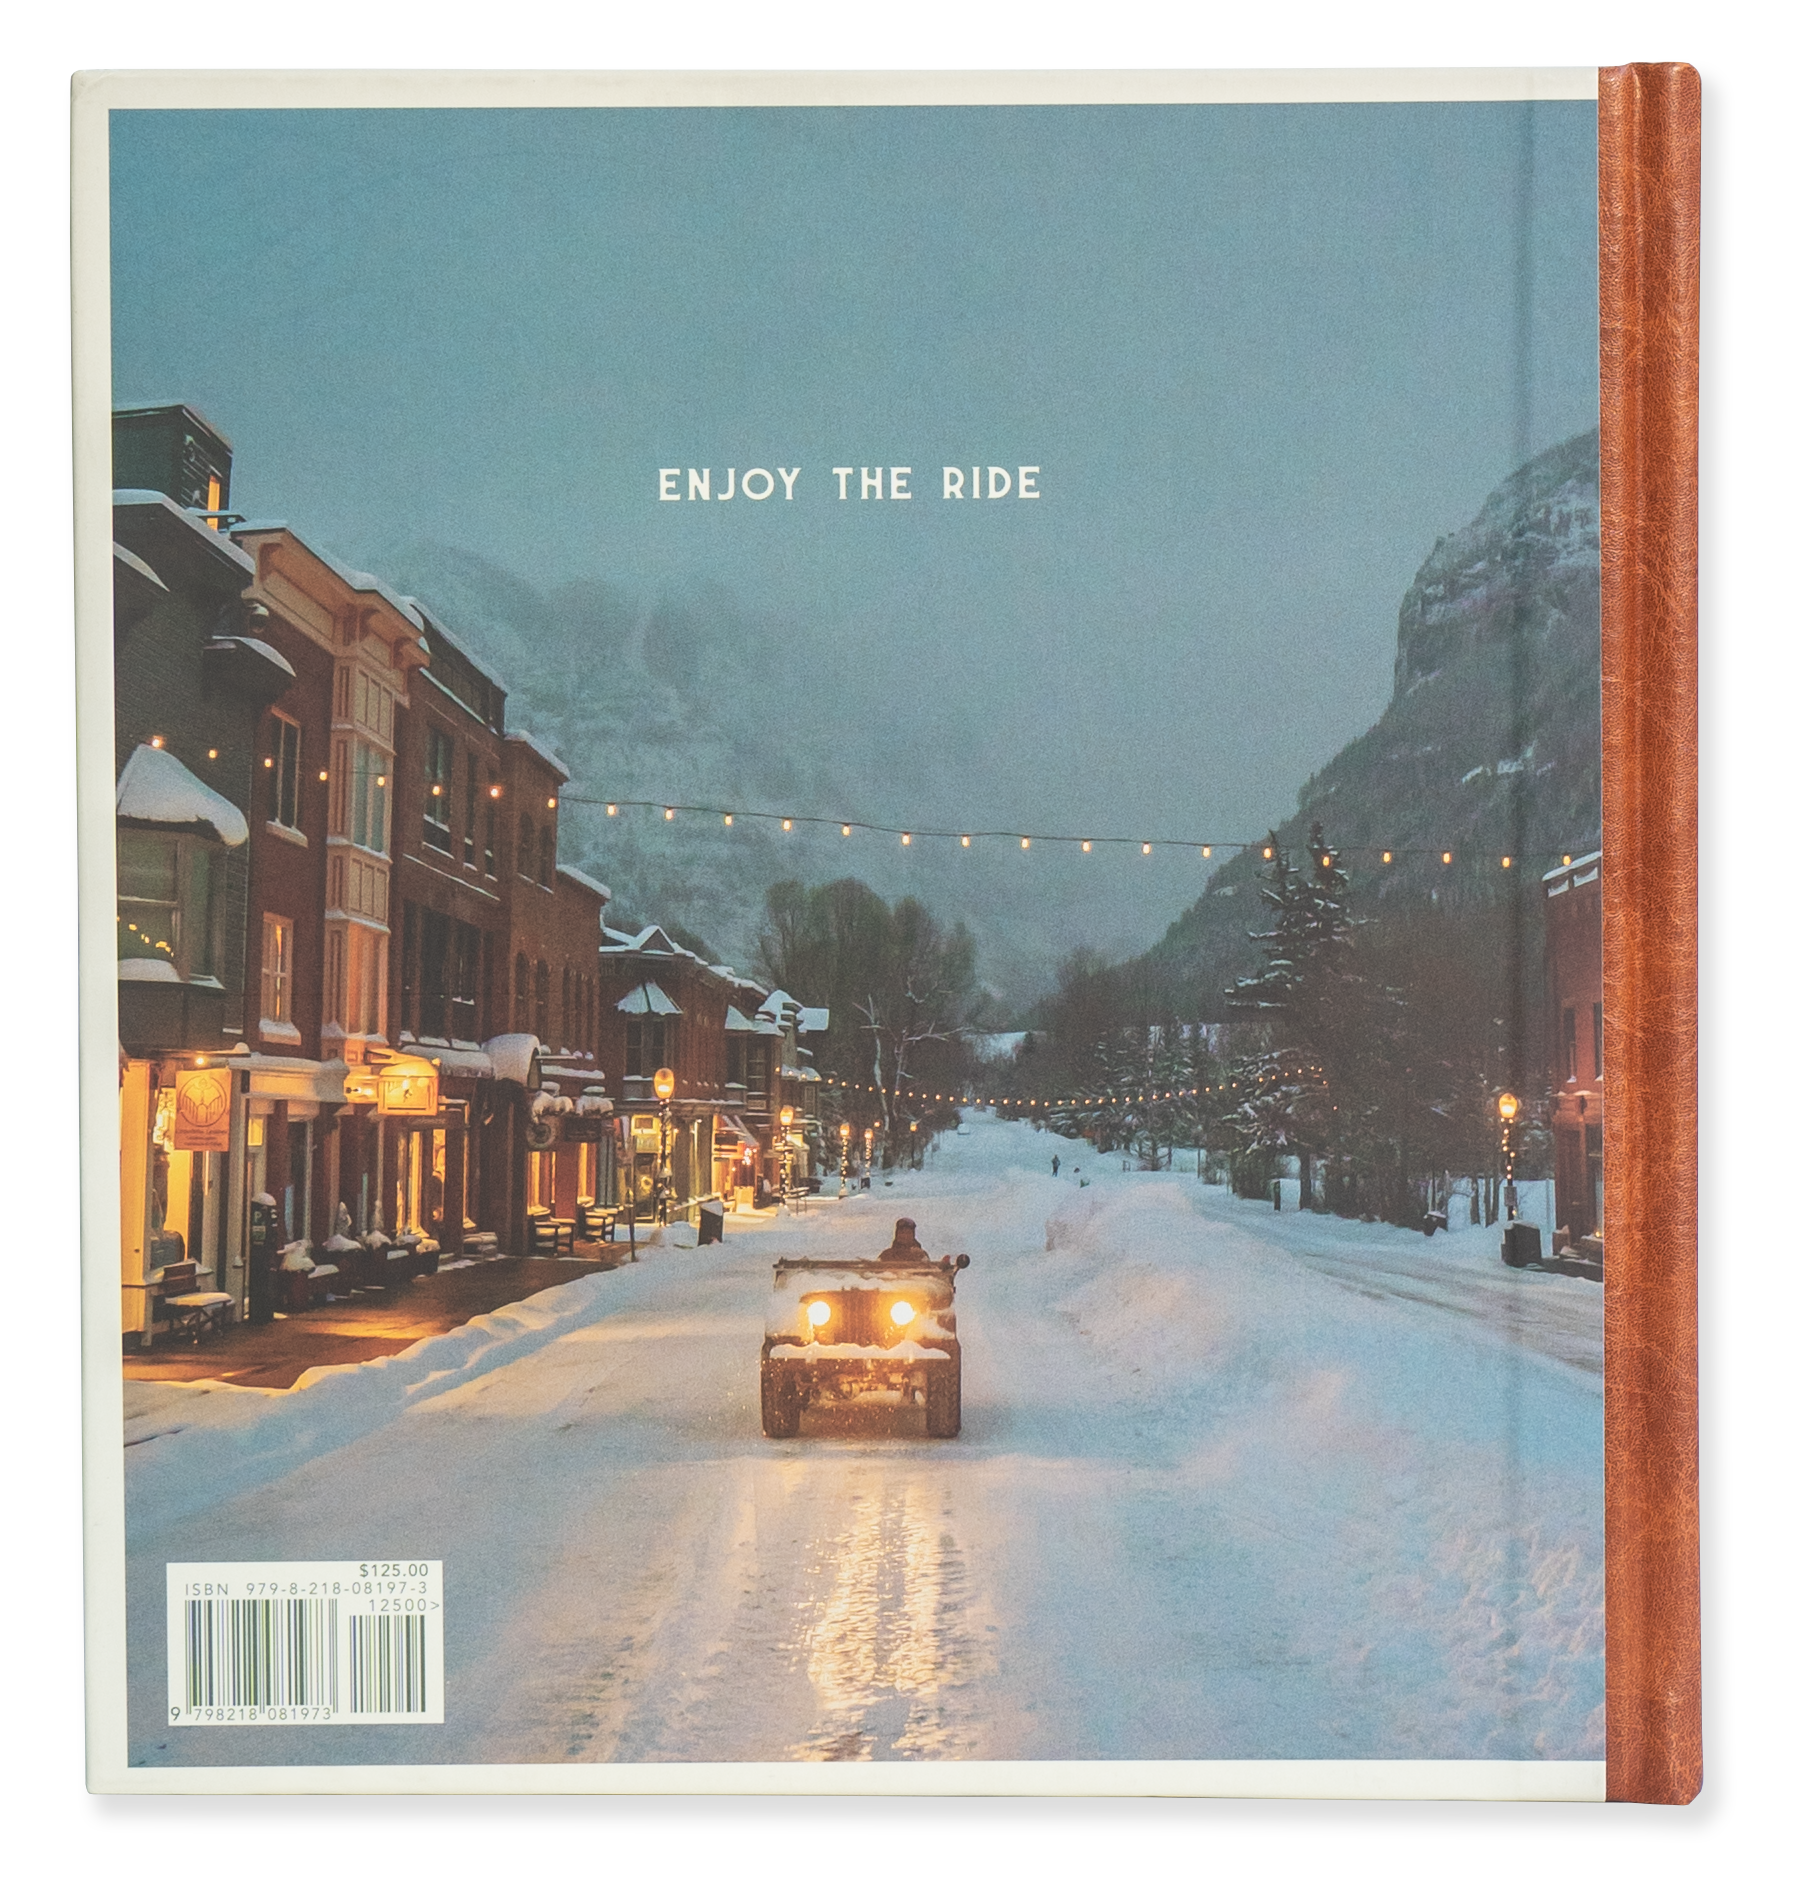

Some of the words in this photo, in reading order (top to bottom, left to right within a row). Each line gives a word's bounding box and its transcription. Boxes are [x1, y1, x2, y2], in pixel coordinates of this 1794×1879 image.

[659, 467, 801, 501] ENJOY
[833, 466, 912, 500] THE
[943, 466, 1040, 499] RIDE
[359, 1563, 429, 1578] $125.00
[185, 1583, 229, 1596] ISBN
[246, 1581, 427, 1595] 979-8-218-08197-3
[170, 1706, 181, 1721] 9
[194, 1708, 258, 1721] 798218
[267, 1707, 331, 1721] 081973
